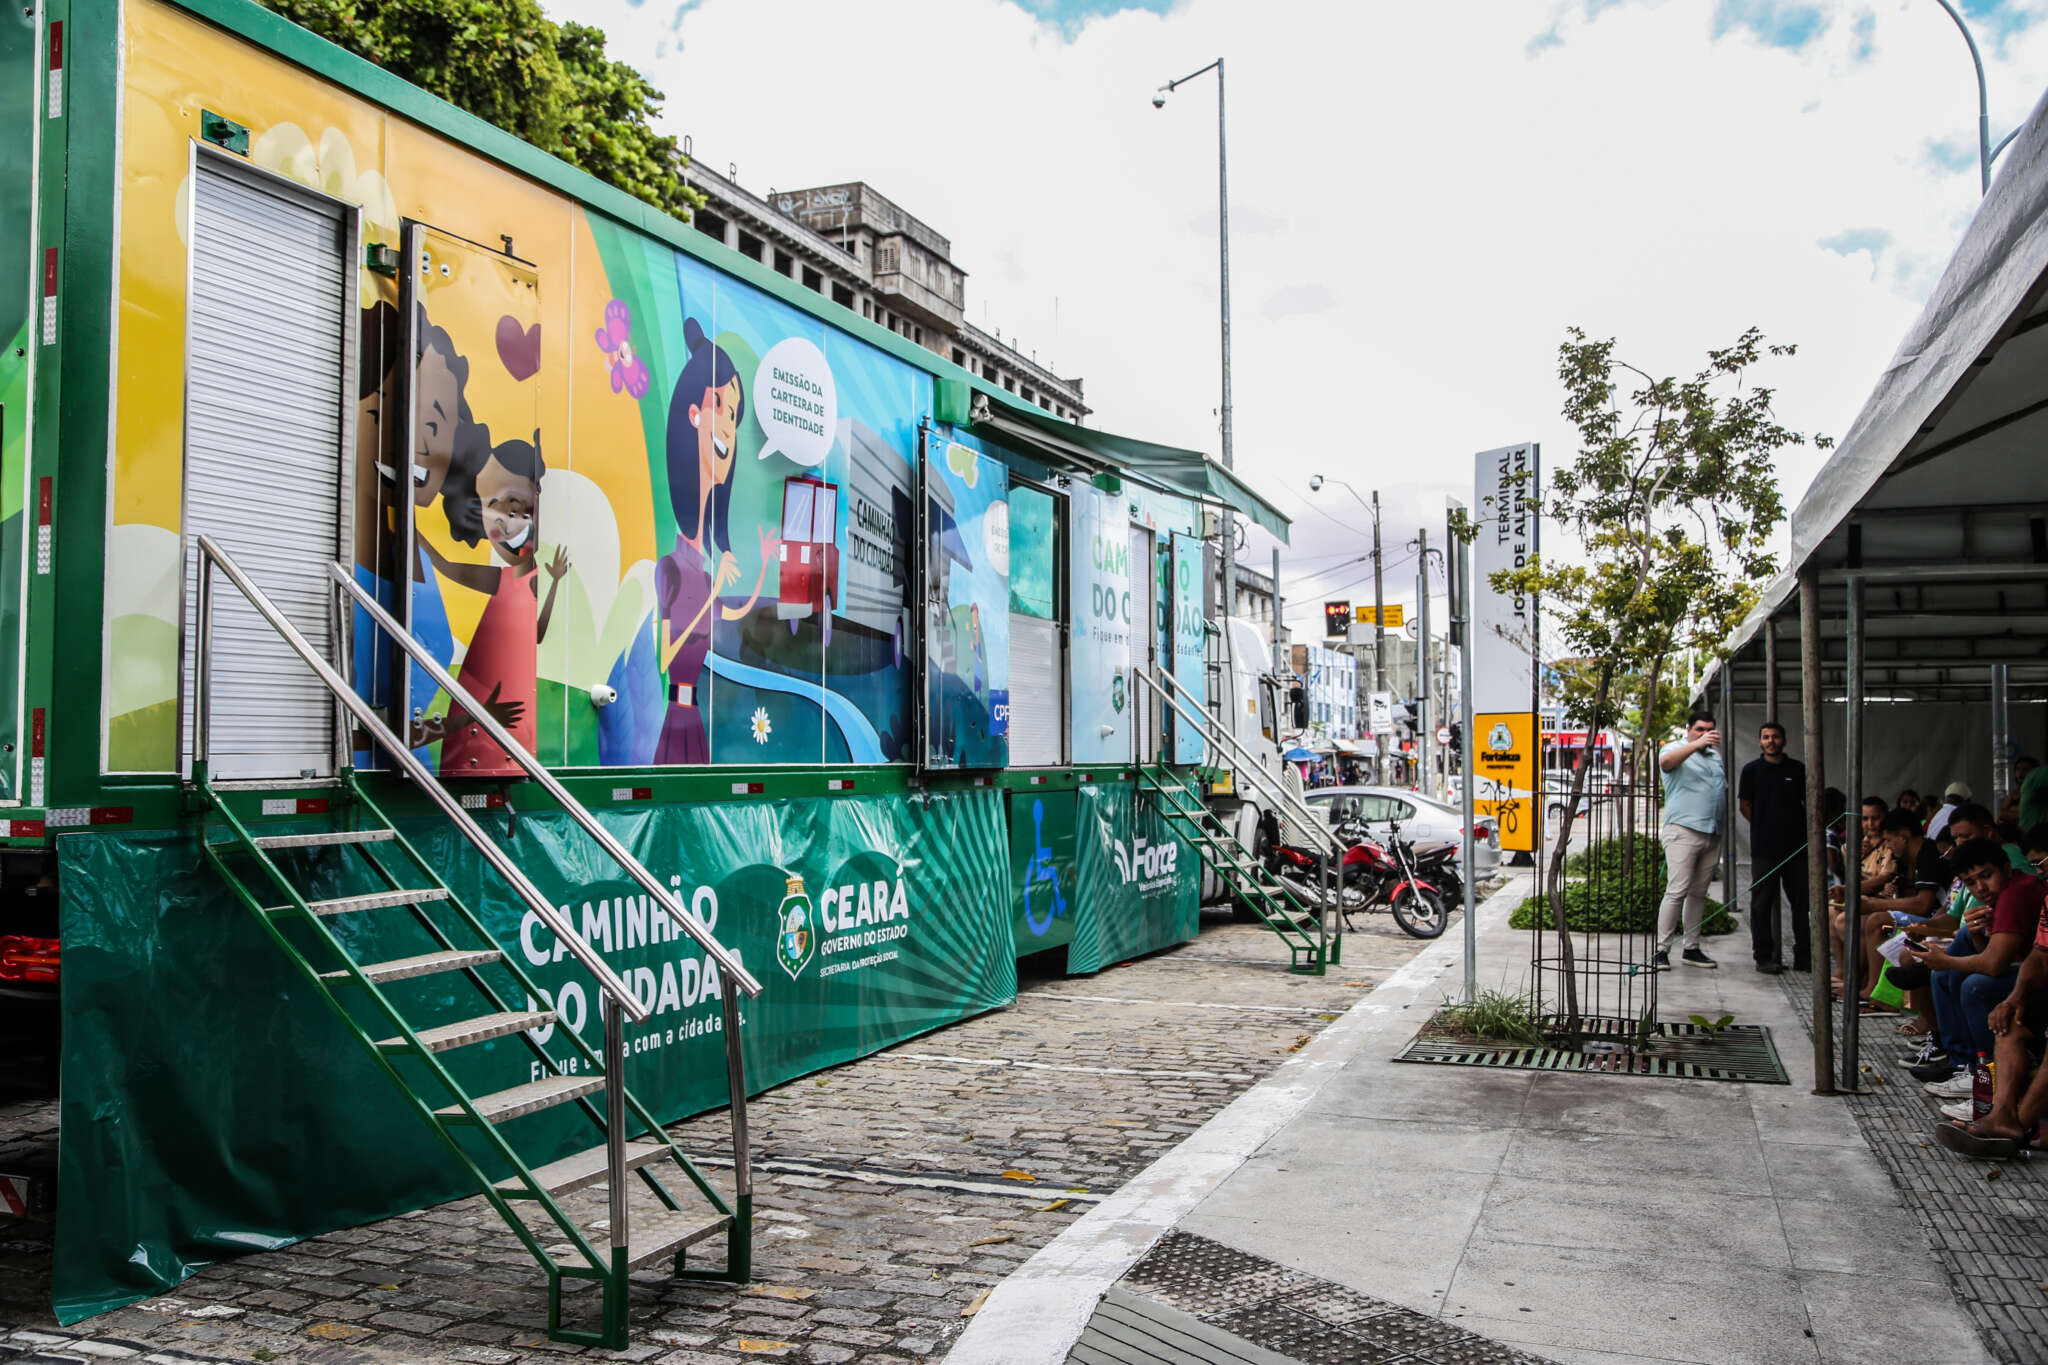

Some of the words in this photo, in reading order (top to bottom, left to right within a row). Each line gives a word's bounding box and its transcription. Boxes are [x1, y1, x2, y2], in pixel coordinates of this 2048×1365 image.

[773, 367, 810, 391] EMISSÃO
[812, 383, 823, 397] DA
[771, 387, 812, 413] CARTEIRA
[814, 403, 824, 417] DE
[773, 408, 824, 436] IDENTIDADE
[1499, 452, 1510, 546] TERMINAL
[1514, 449, 1526, 537] ALENCAR
[857, 499, 895, 545] CAMINHÃO
[853, 534, 865, 562] DO
[867, 542, 895, 575] CIDADÃO
[1514, 543, 1526, 568] DE
[1092, 583, 1116, 621] DO
[1514, 575, 1526, 619] JOS
[994, 704, 1010, 721] CPF
[1481, 752, 1520, 762] Fortaleza
[1132, 838, 1177, 882] Force
[821, 863, 909, 933] CEARÁ
[821, 934, 861, 956] GOVERNO
[863, 930, 876, 946] DO
[877, 924, 908, 943] ESTADO
[820, 962, 850, 978] SECRETARIA
[852, 960, 860, 970] DA
[531, 1056, 577, 1083] Fiue
[634, 1033, 661, 1054] com
[666, 1028, 674, 1045] a
